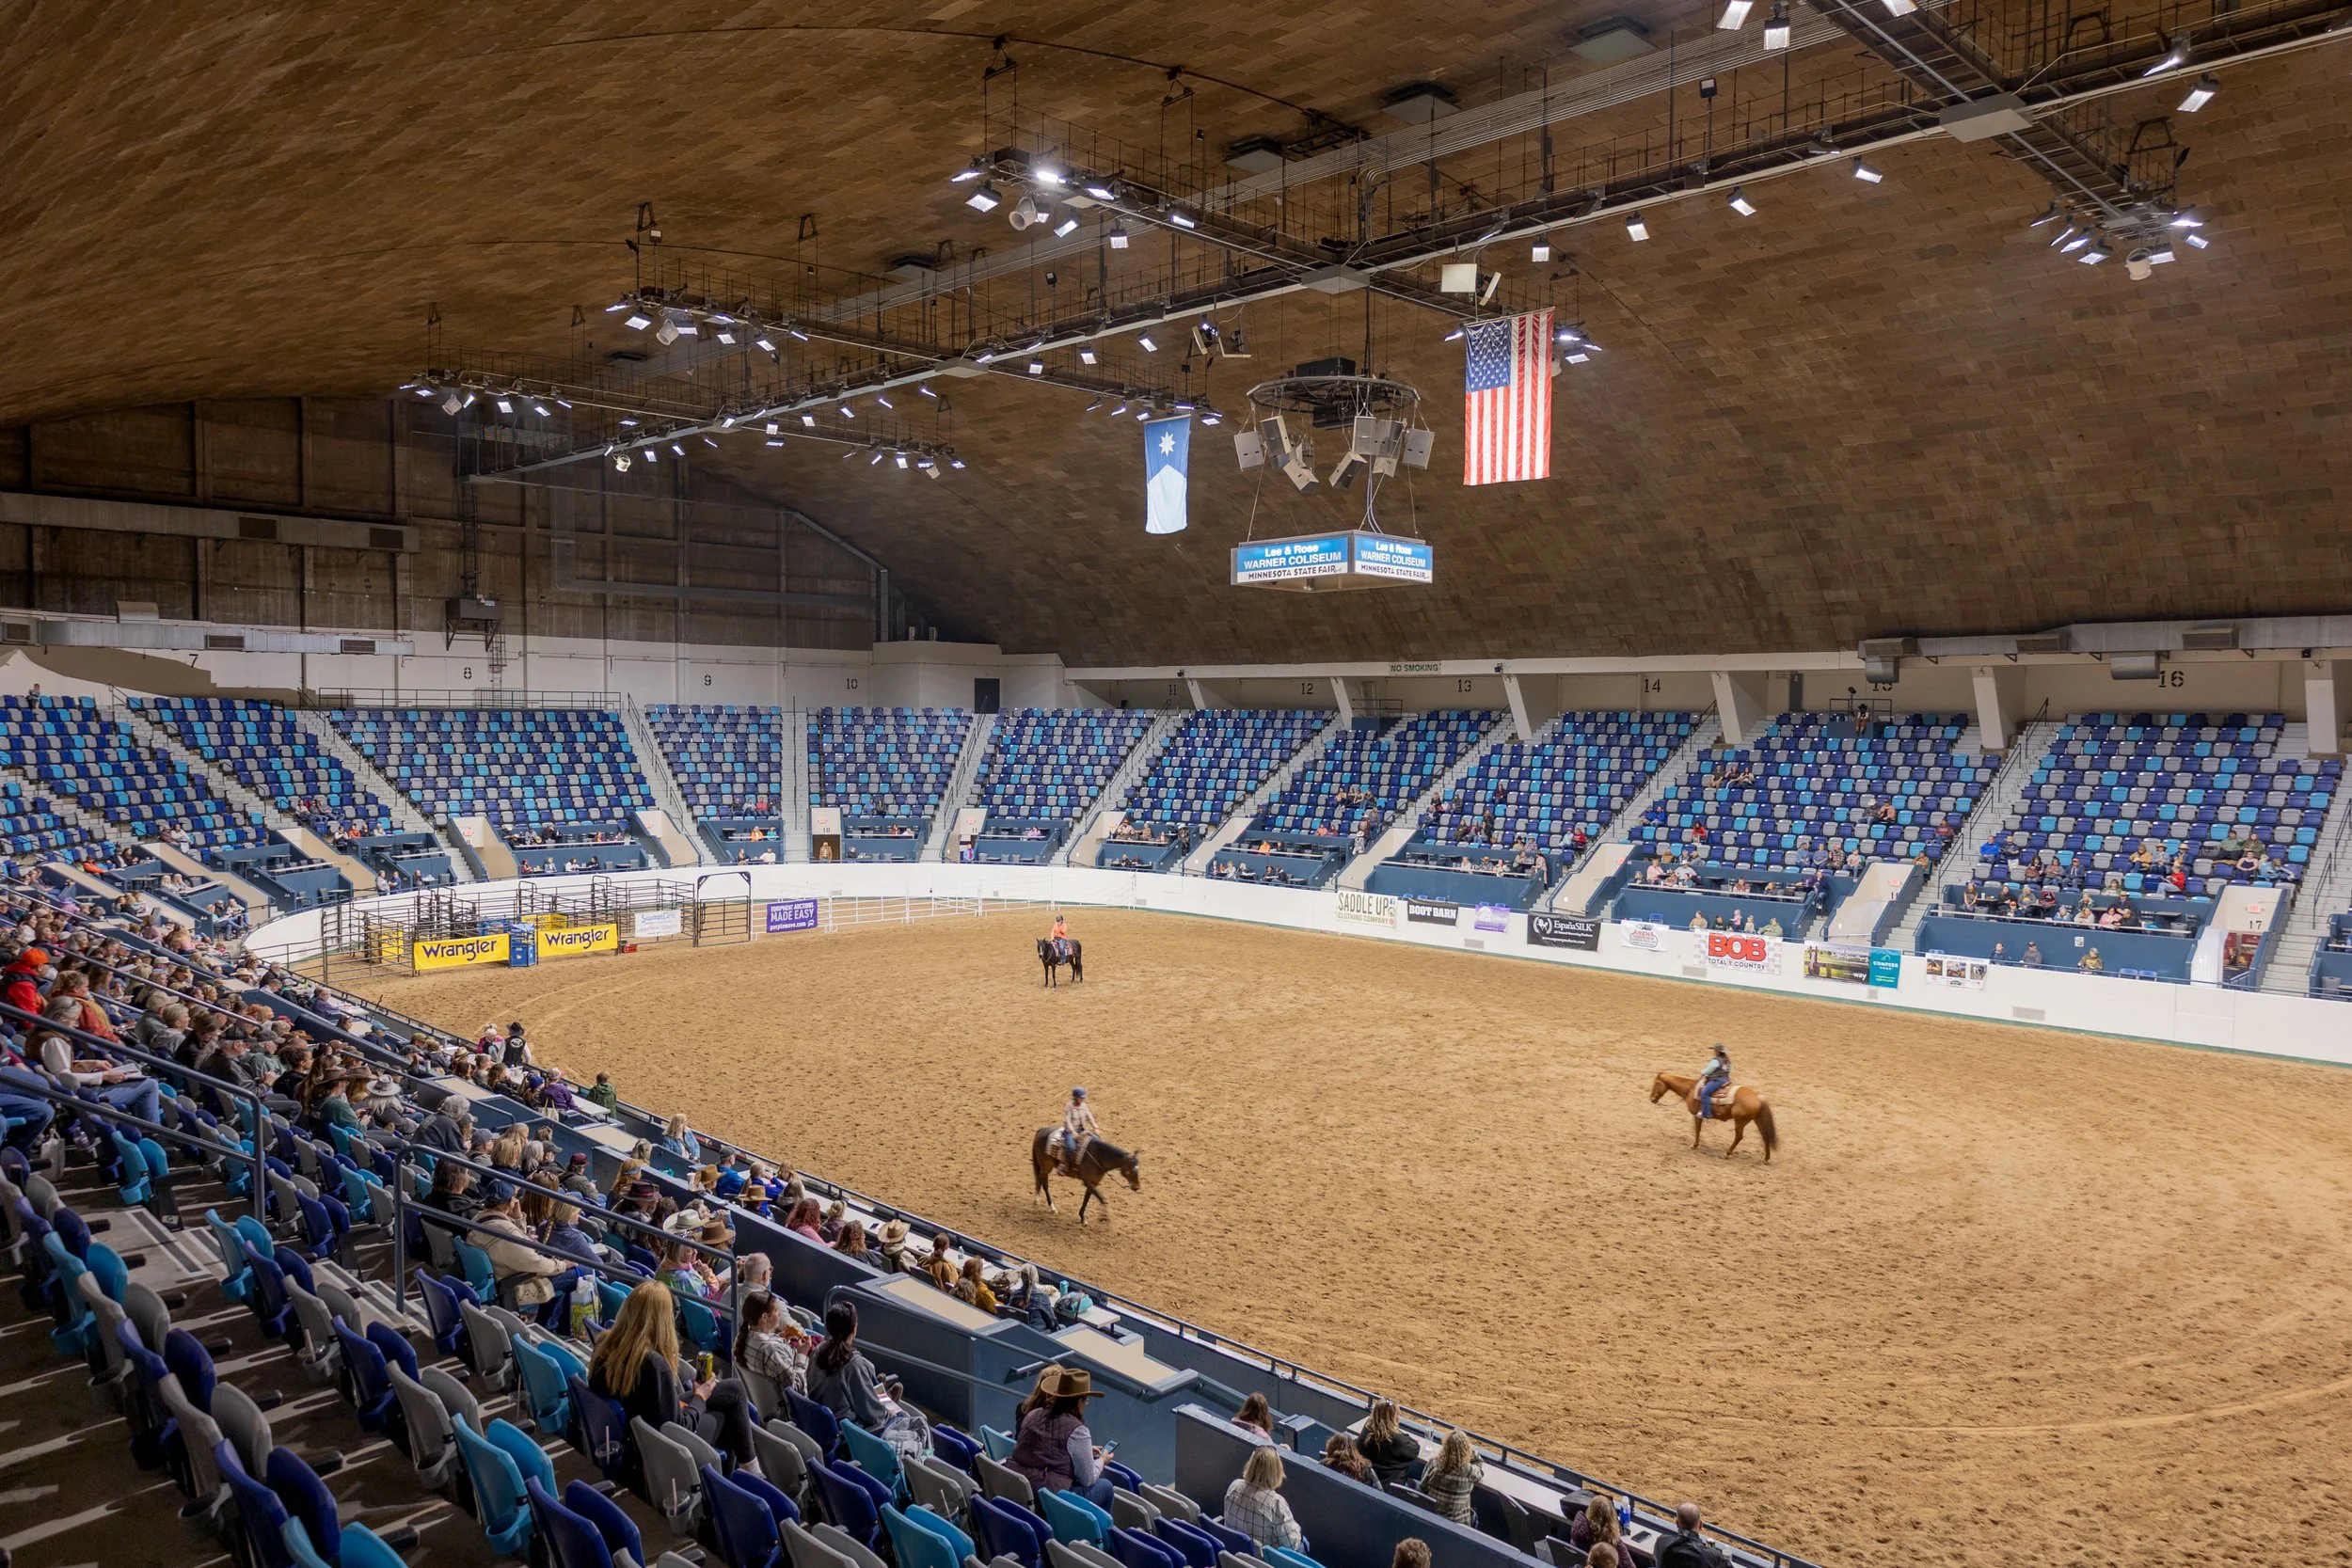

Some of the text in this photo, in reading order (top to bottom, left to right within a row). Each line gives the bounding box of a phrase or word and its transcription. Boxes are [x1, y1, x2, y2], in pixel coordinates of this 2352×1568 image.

[1264, 545, 1319, 557] Lee & Rose
[1375, 542, 1388, 551] Lee
[1244, 551, 1342, 569] WARNER COLISEUM
[1361, 550, 1426, 567] WARNER COLISEUM
[1248, 568, 1292, 579] MINNESOTA
[1294, 566, 1316, 576] STATE
[1318, 564, 1336, 573] FAIR
[1361, 564, 1394, 575] MINNESOTA
[1396, 568, 1412, 577] STATE
[189, 654, 199, 668] 7
[1405, 663, 1438, 672] SMOKING
[464, 667, 471, 679] 8
[2159, 670, 2185, 688] 16
[704, 674, 711, 686] 9
[847, 678, 858, 689] 10
[1457, 679, 1471, 692] 13
[1645, 678, 1661, 692] 14
[1168, 684, 1176, 695] 11
[1301, 683, 1313, 694] 12
[1338, 892, 1389, 916] SADDLE UP
[771, 909, 814, 922] MADE EASY
[1338, 912, 1388, 924] CLOTHING COMPANY
[1408, 905, 1456, 919] BOOT BARN
[770, 922, 806, 931] purplewave.com
[2249, 920, 2262, 929] 17
[545, 928, 609, 949] Wrangler
[422, 940, 497, 960] Wrangler
[1708, 932, 1766, 961] BOB
[1734, 960, 1765, 970] COUNTRY
